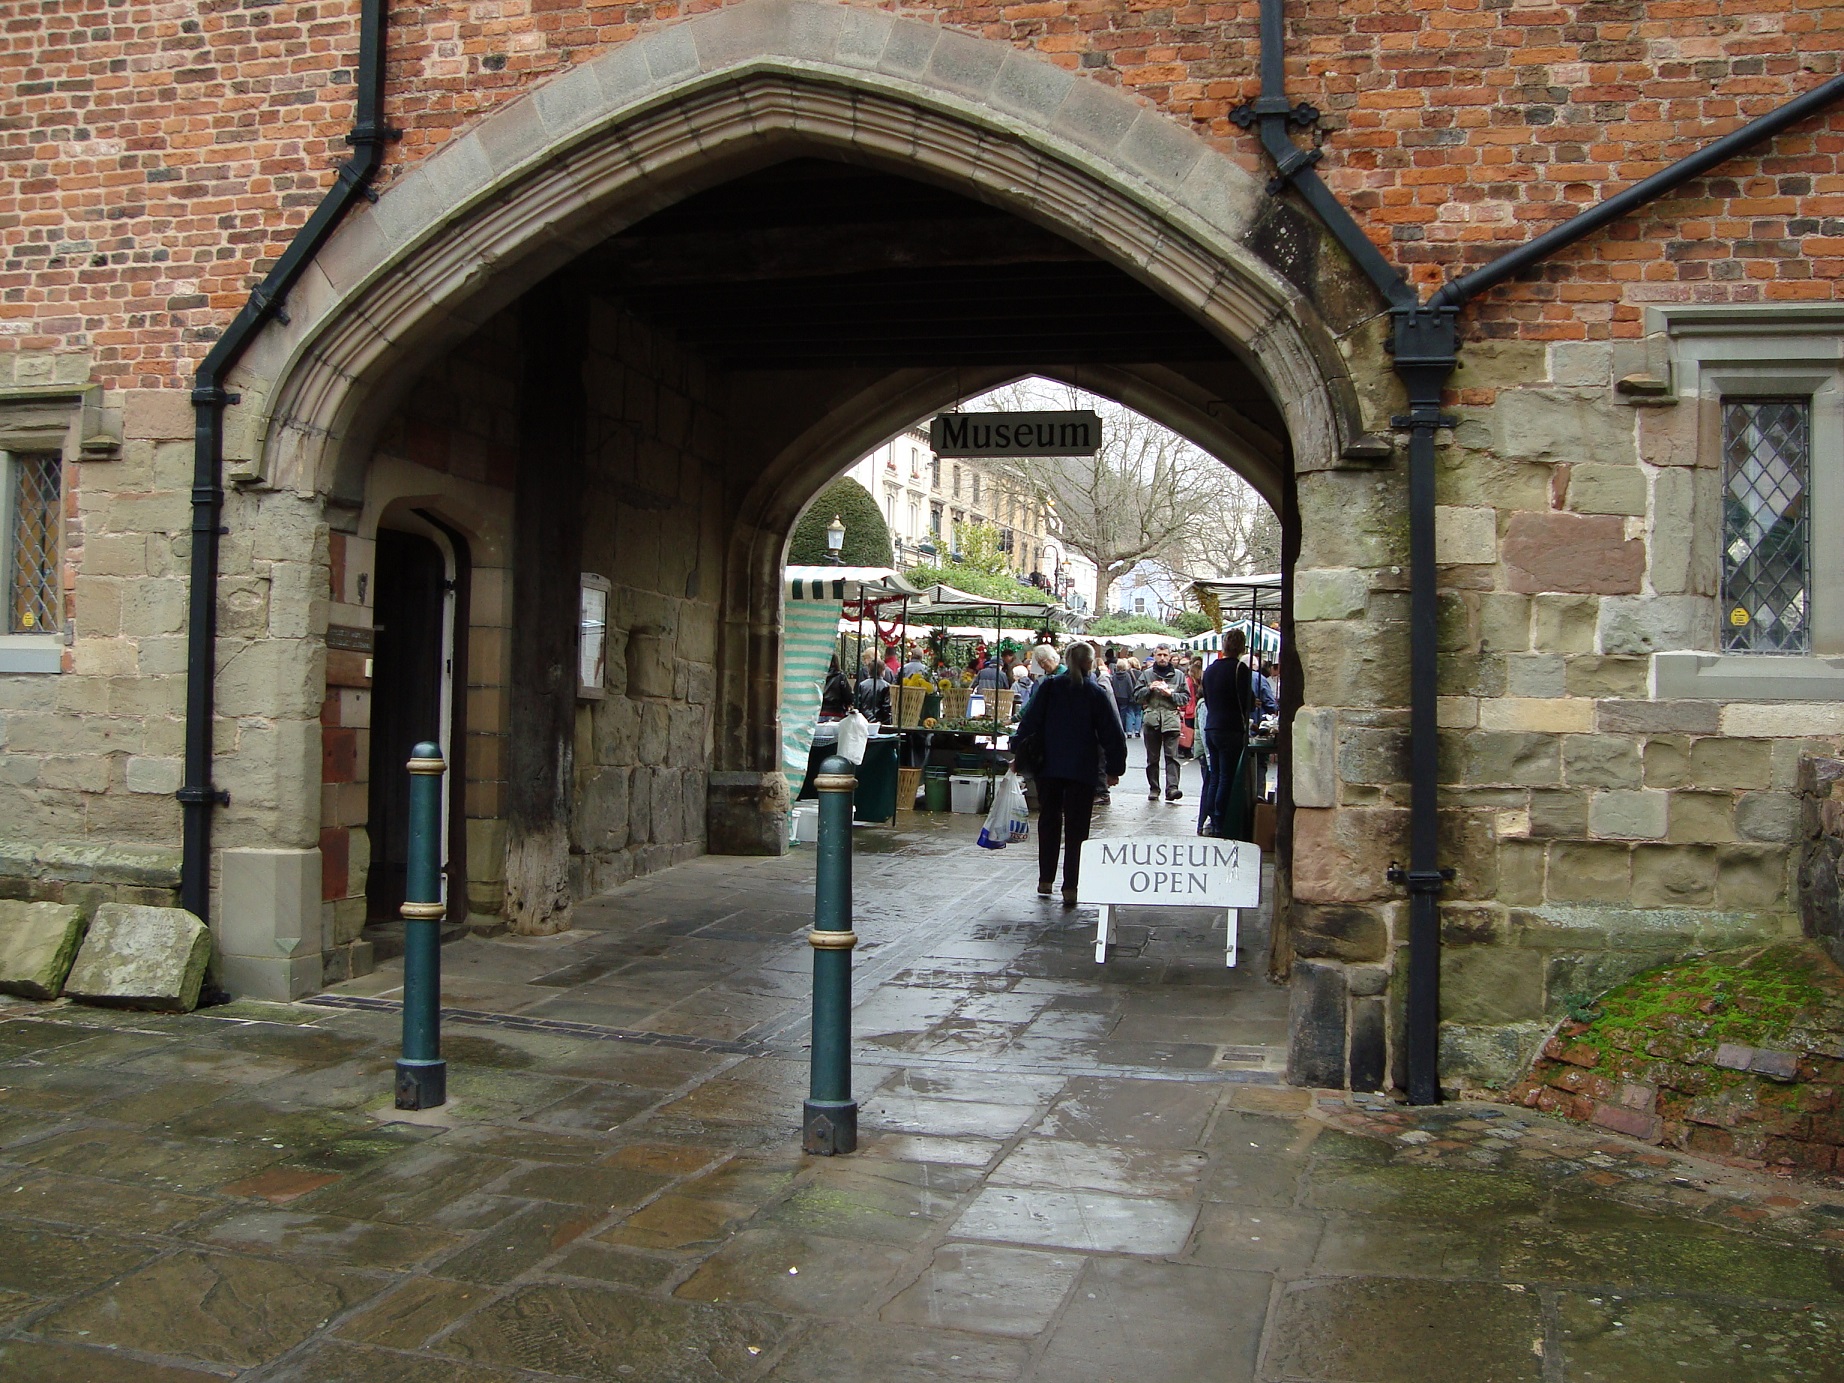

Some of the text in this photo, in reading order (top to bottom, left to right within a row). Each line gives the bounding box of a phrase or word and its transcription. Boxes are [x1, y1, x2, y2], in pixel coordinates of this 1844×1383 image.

[941, 416, 1091, 450] Museum
[1101, 843, 1240, 868] MUSEUM
[1129, 871, 1208, 894] OPEN
